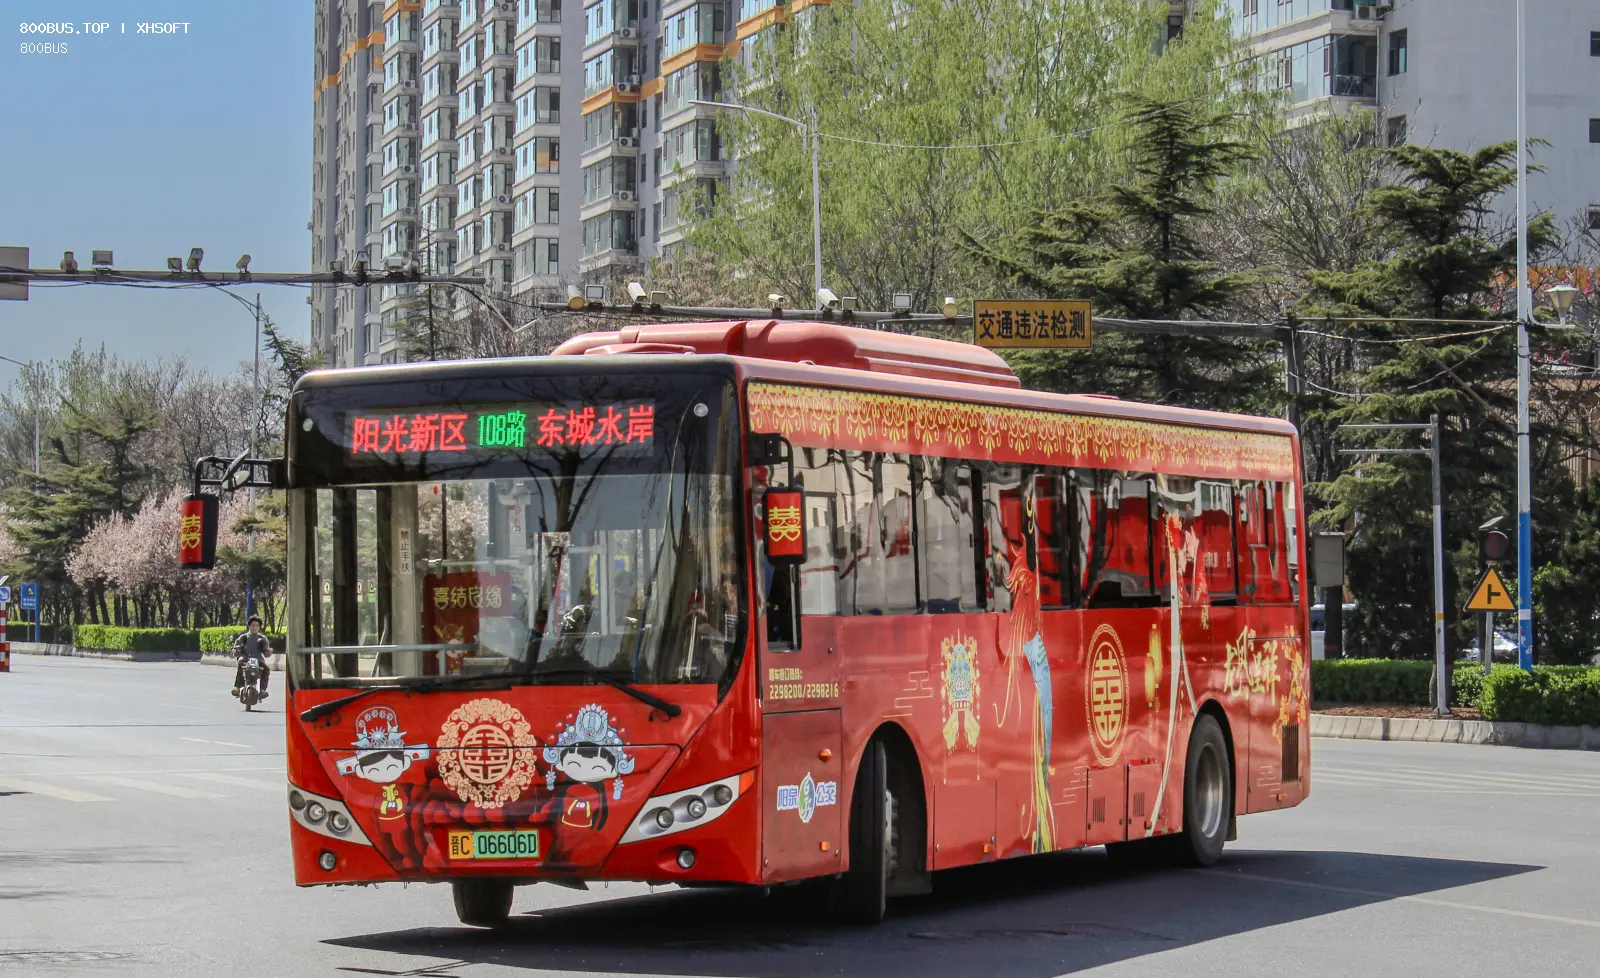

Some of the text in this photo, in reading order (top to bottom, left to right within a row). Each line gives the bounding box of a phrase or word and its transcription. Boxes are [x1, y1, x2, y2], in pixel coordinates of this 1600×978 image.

[978, 309, 1086, 340] 交通违法检测
[352, 405, 655, 453] 阳光新区 108路 东城水岸
[400, 530, 411, 573] 禁止手扶
[433, 584, 503, 611] 喜结良缘
[769, 683, 839, 700] 2298200/2298216
